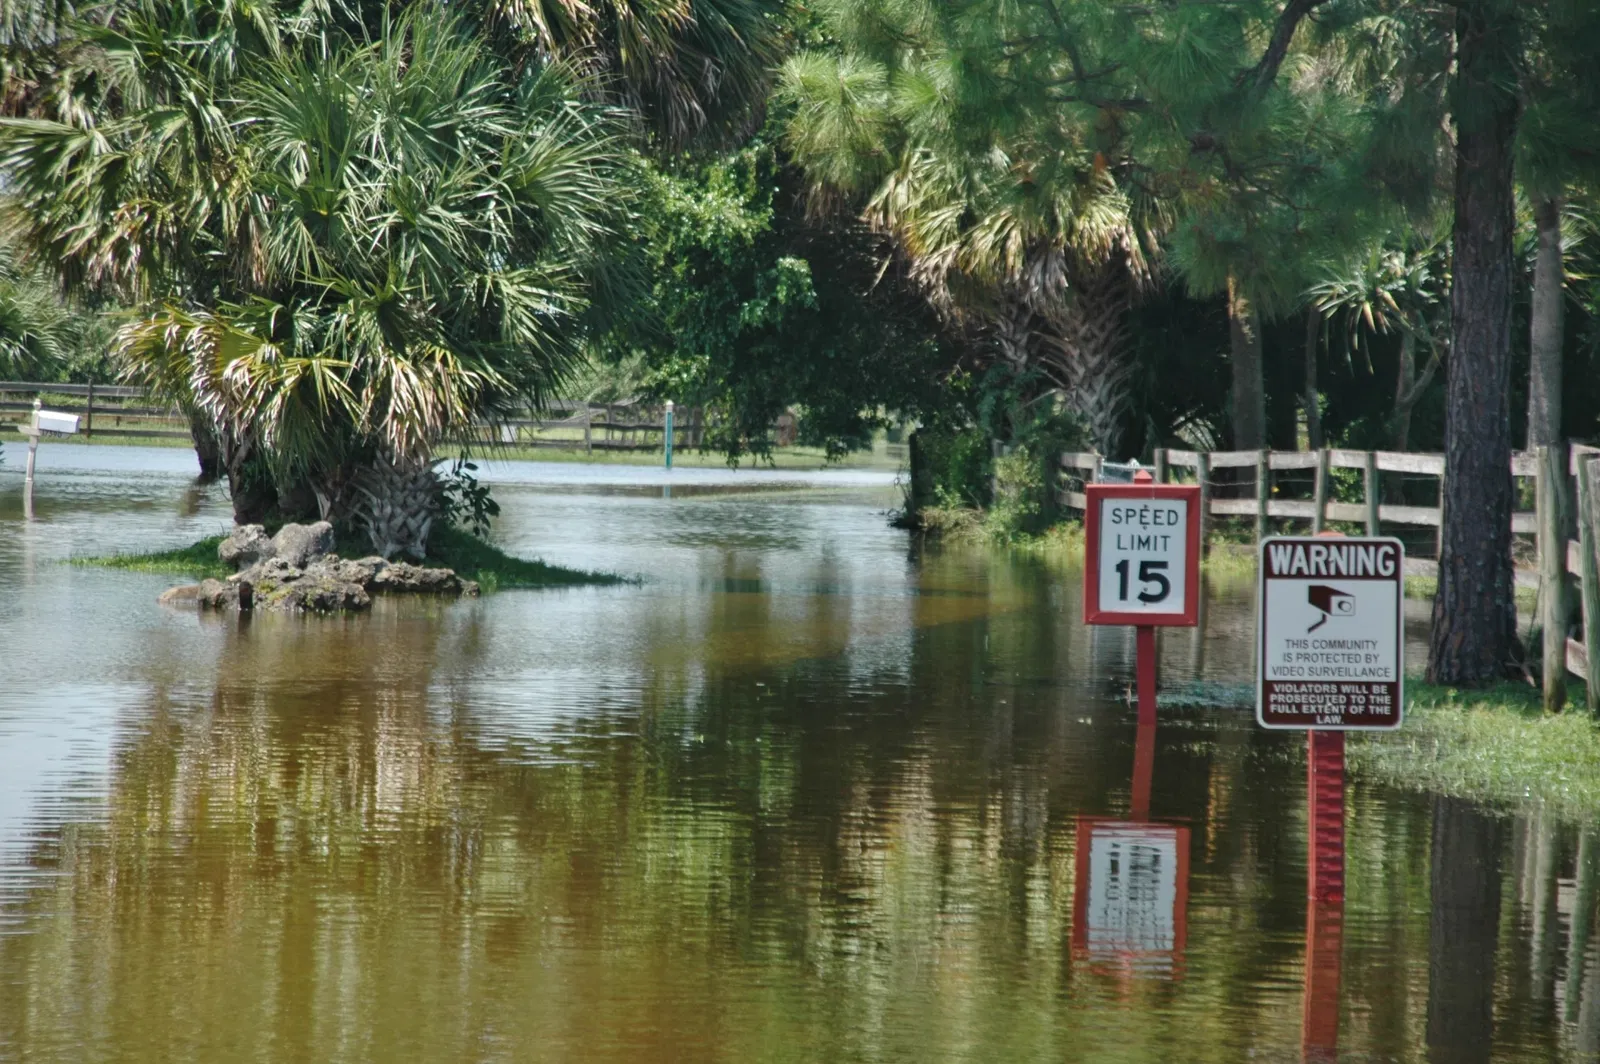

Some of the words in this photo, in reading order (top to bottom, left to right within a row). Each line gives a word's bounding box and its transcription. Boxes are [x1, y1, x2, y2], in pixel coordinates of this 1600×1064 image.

[1112, 508, 1178, 526] SPEED
[1117, 534, 1171, 551] LIMIT
[1269, 544, 1395, 577] WARNING
[1115, 559, 1171, 603] 15
[1285, 639, 1309, 649] THIS
[1312, 639, 1378, 650] COMMUNITY
[1283, 652, 1293, 663] IS
[1296, 653, 1362, 663] PROTECTED
[1365, 653, 1380, 664] BY
[1272, 666, 1304, 676] VIDEO
[1308, 666, 1391, 678] SURVEILLANCE
[1273, 684, 1337, 693] VIOLATORS
[1341, 685, 1368, 694] WILL
[1372, 685, 1388, 694] BE
[1270, 694, 1347, 704] PROSECUTED
[1350, 695, 1366, 704] TO
[1369, 695, 1391, 705] THE
[1270, 704, 1299, 714] FULL
[1302, 705, 1346, 714] EXTENT
[1349, 705, 1365, 714] OF
[1369, 705, 1391, 715] THE
[1316, 715, 1344, 725] LAW.
